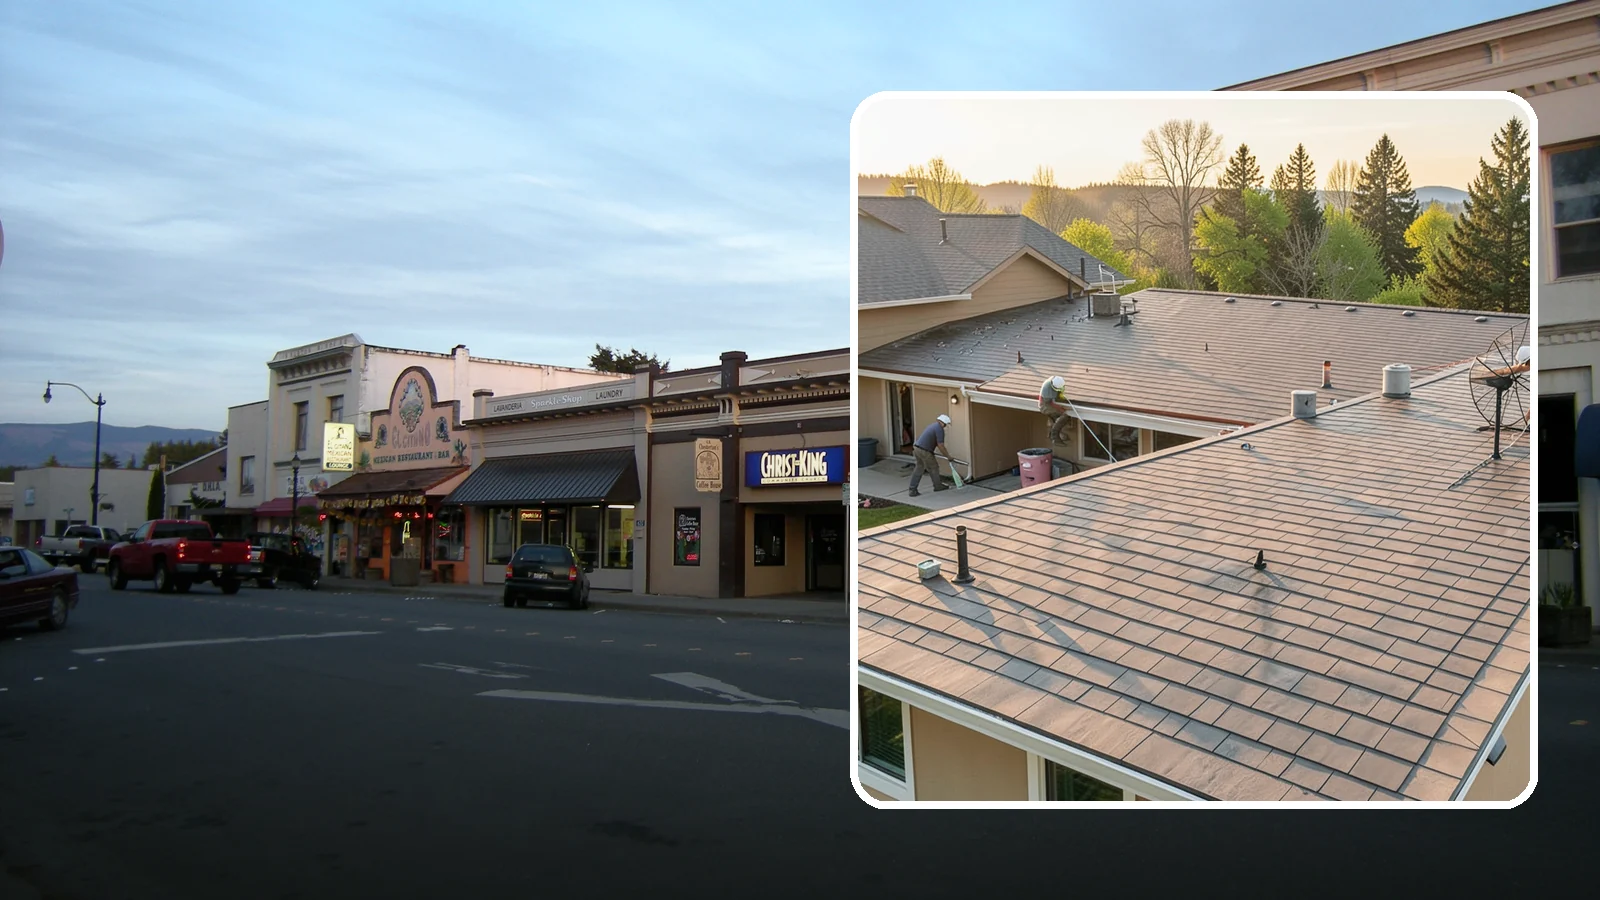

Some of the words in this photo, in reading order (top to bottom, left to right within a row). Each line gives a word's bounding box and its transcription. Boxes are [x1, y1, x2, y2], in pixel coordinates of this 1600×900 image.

[493, 402, 522, 412] LAVANDERIA
[530, 397, 561, 409] Sparkle
[561, 394, 582, 404] Shop
[595, 389, 623, 400] LAUNDRY
[373, 455, 396, 465] MEXICAN
[397, 451, 433, 463] RESTAURANT
[438, 450, 450, 459] BAR
[760, 451, 797, 478] CHRIST
[799, 450, 827, 476] KING
[696, 481, 709, 489] Coffee
[710, 481, 722, 489] House
